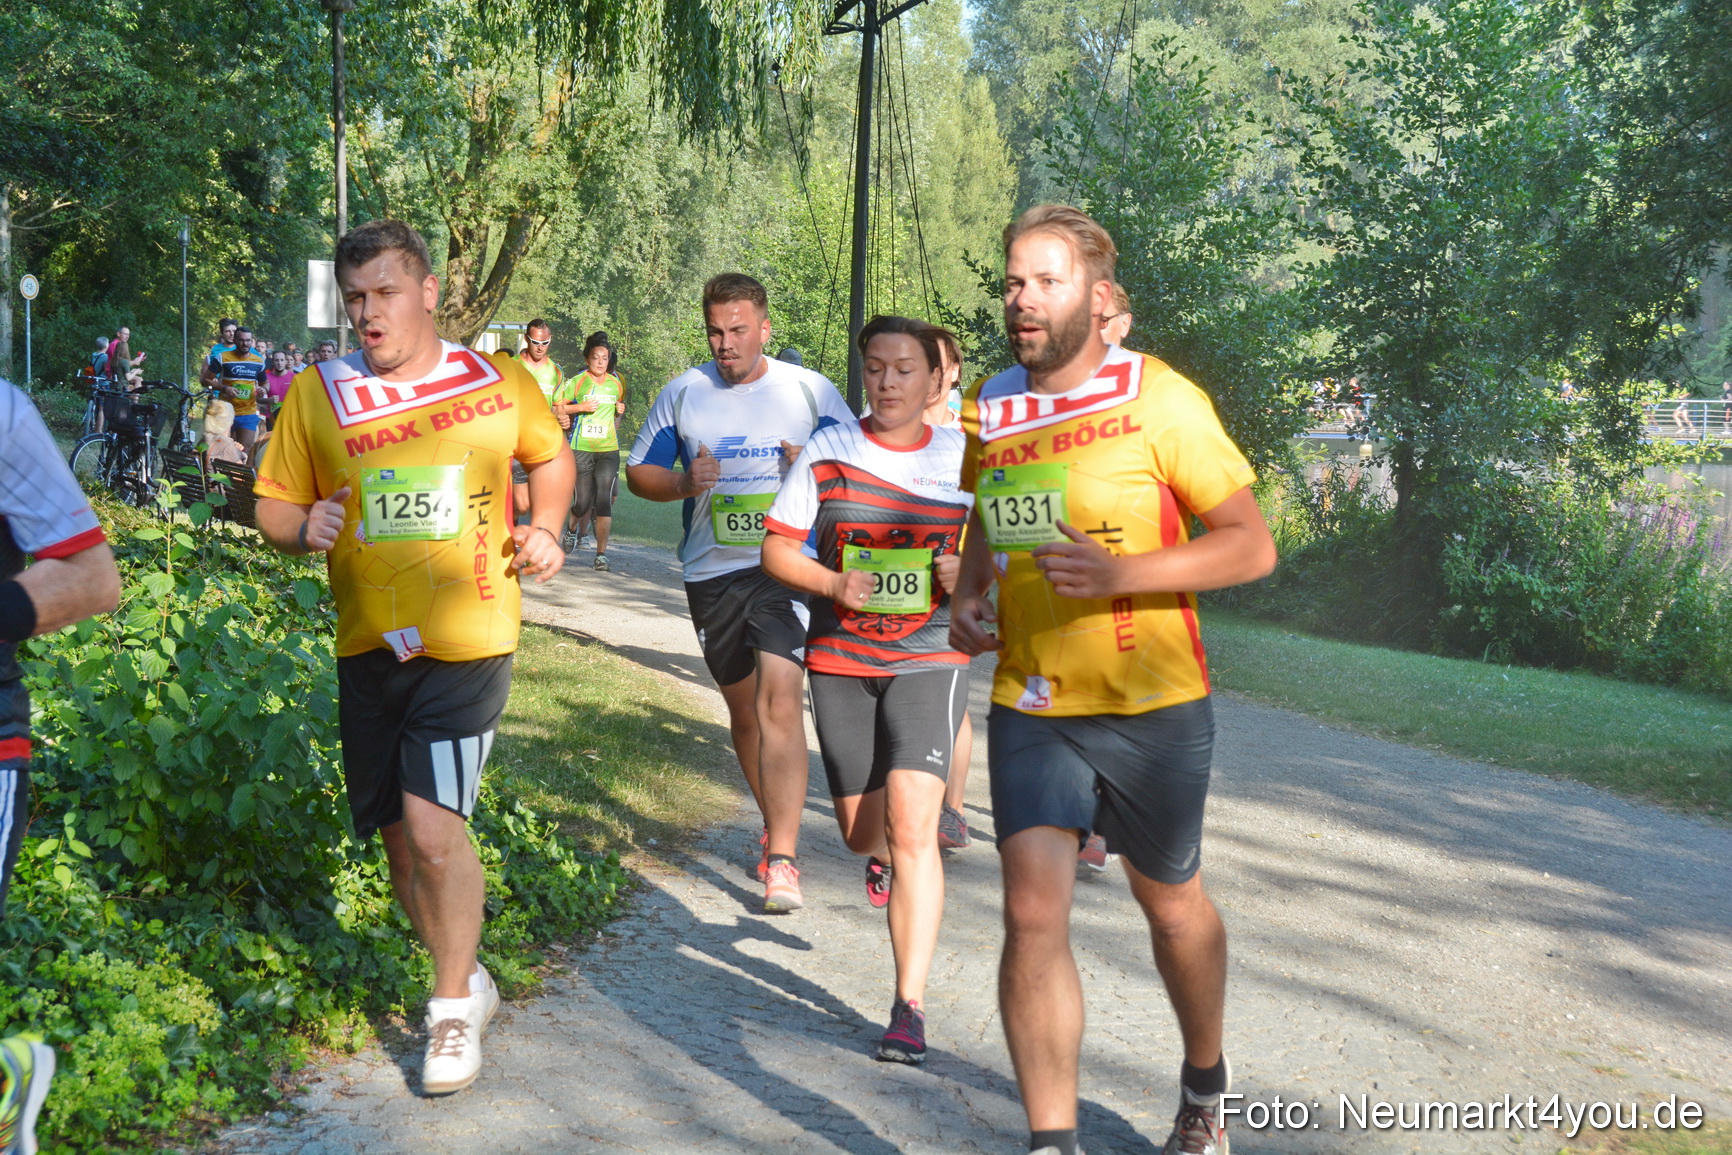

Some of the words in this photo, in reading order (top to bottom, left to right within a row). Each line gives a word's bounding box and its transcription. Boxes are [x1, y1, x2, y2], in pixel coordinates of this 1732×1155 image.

[344, 420, 423, 458] MAX
[429, 393, 513, 432] BÖGL
[587, 425, 603, 433] 213
[980, 440, 1040, 469] MAX
[1053, 414, 1141, 454] BÖGL
[375, 492, 451, 520] 1254
[989, 494, 1051, 527] 1331
[389, 520, 419, 529] Leontie
[727, 512, 765, 531] 638
